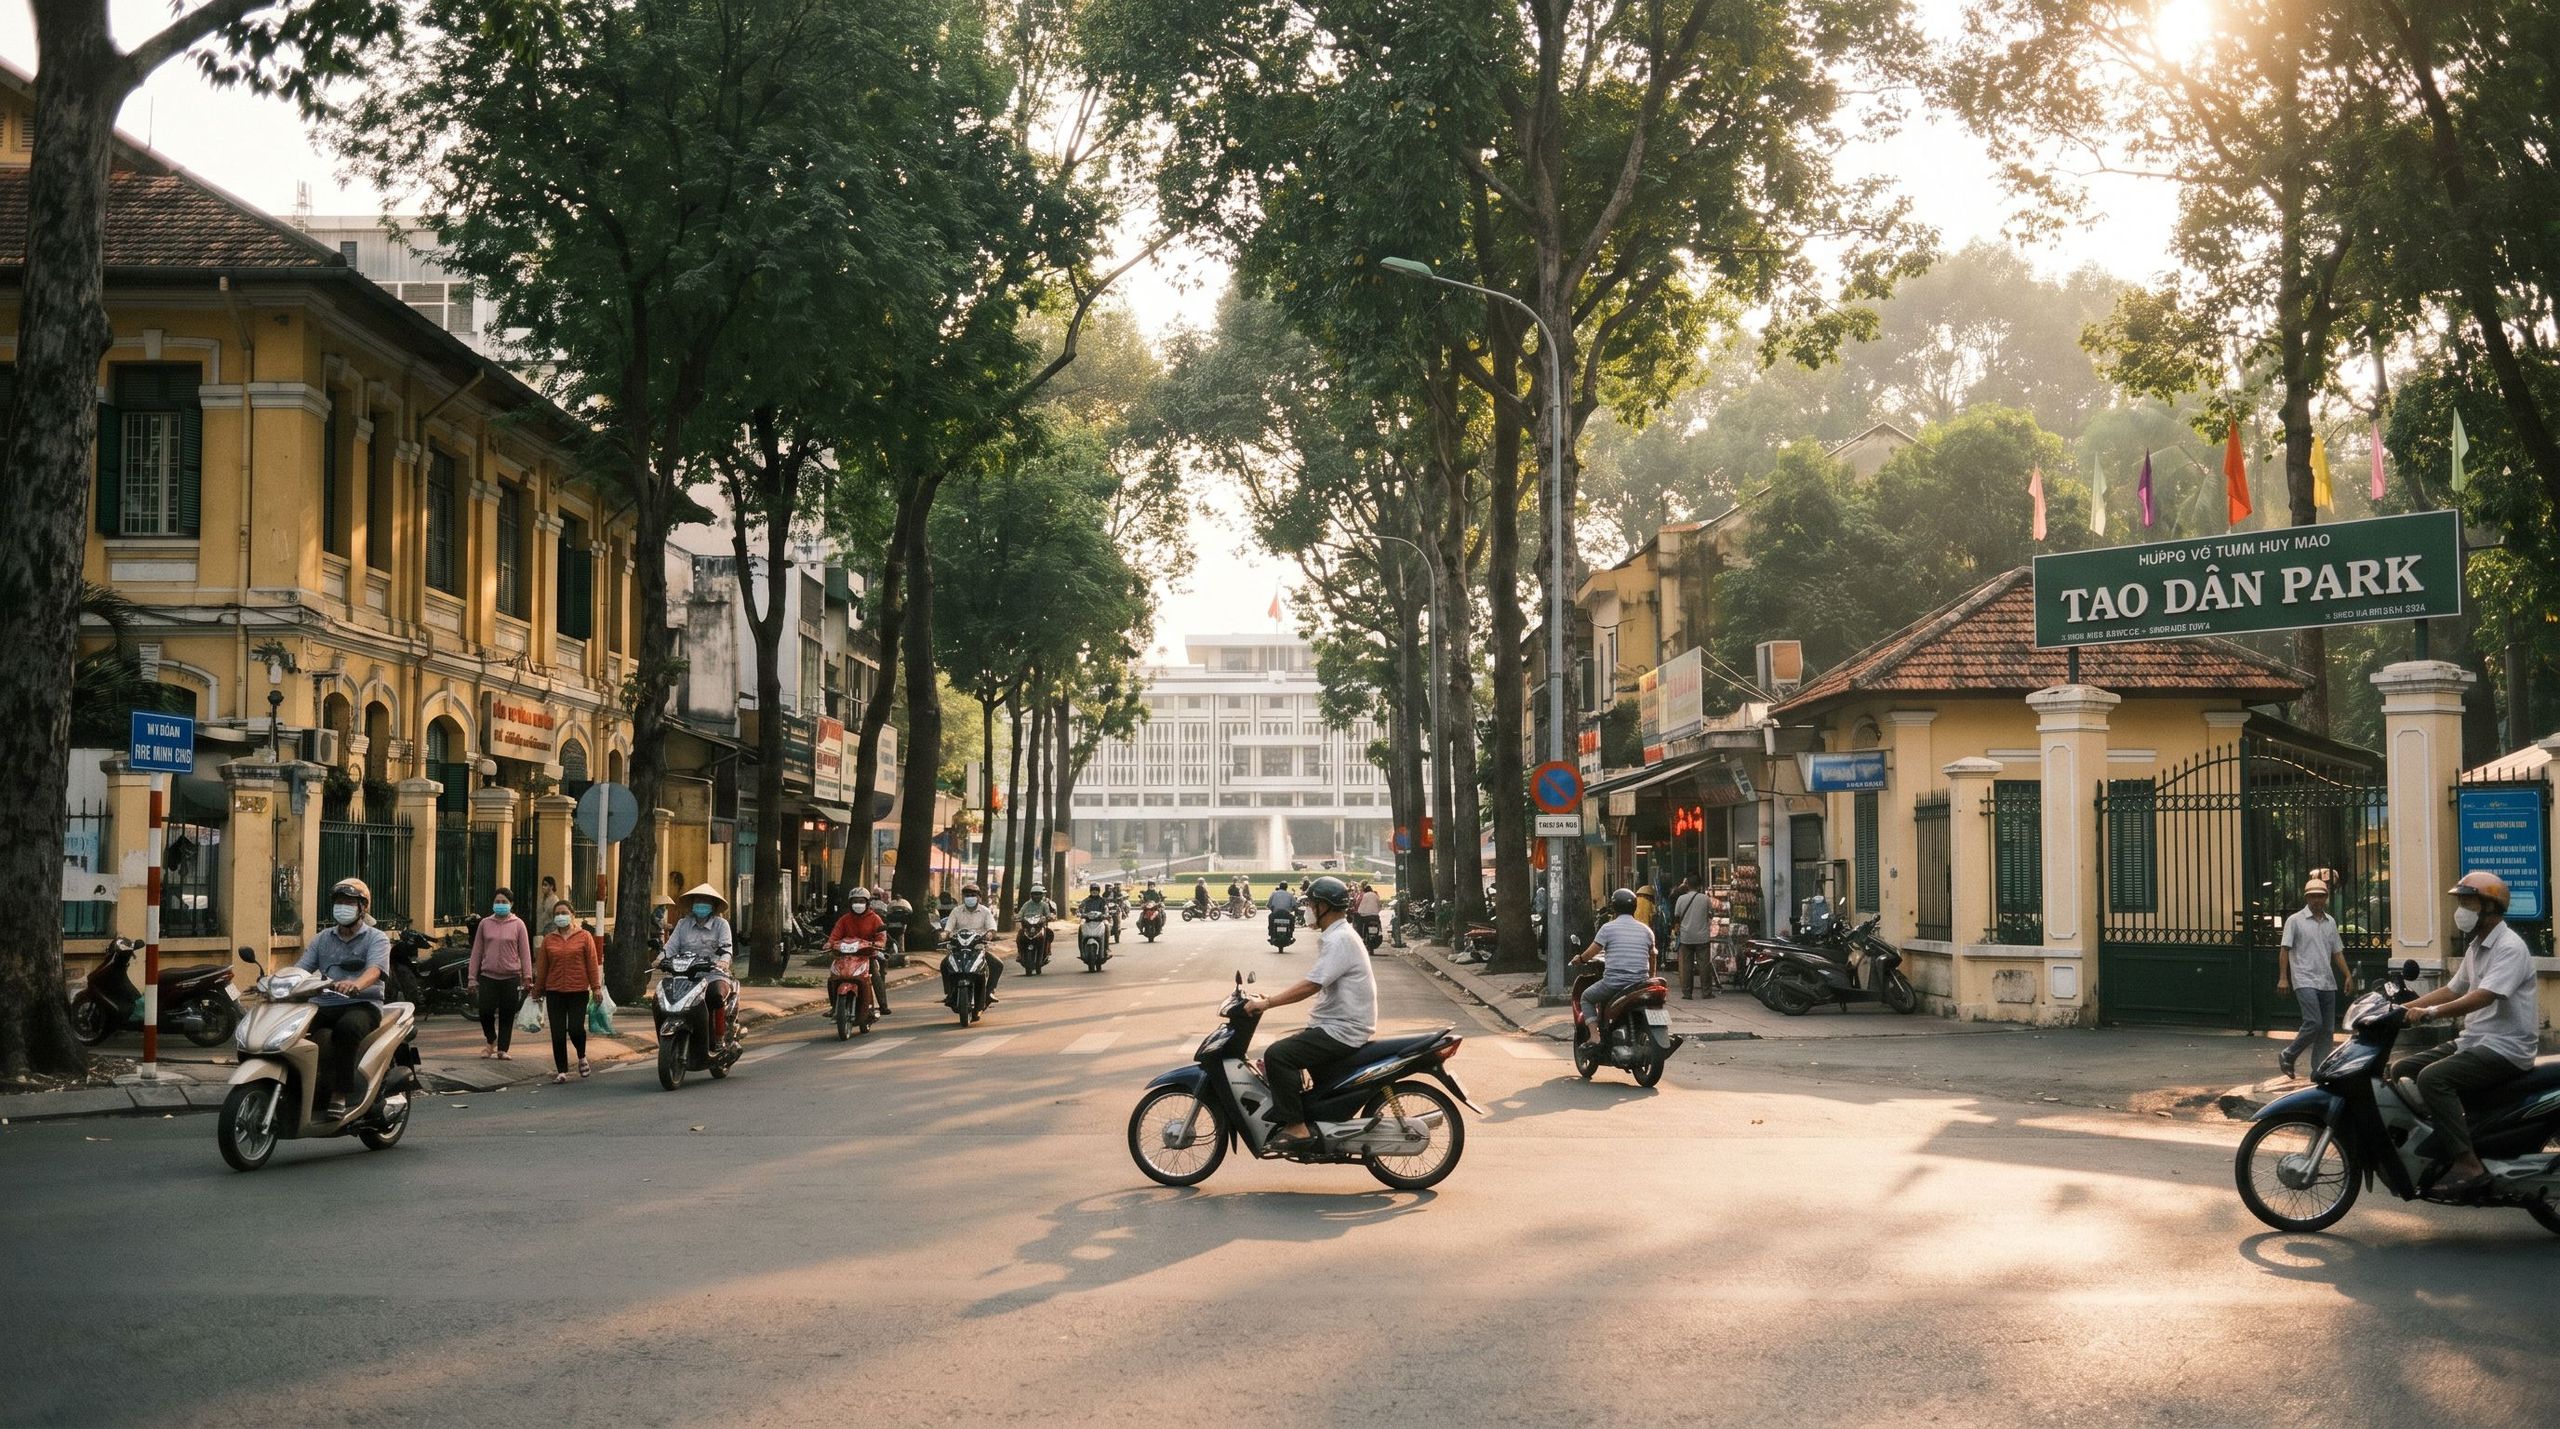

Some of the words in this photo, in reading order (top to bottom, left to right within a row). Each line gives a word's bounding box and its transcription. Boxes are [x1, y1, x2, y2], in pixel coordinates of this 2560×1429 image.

[2260, 538, 2290, 553] HUY
[2295, 533, 2331, 549] MAO
[2060, 582, 2149, 623] TAO
[2163, 563, 2265, 614] DÂN
[2281, 554, 2425, 604] PARK
